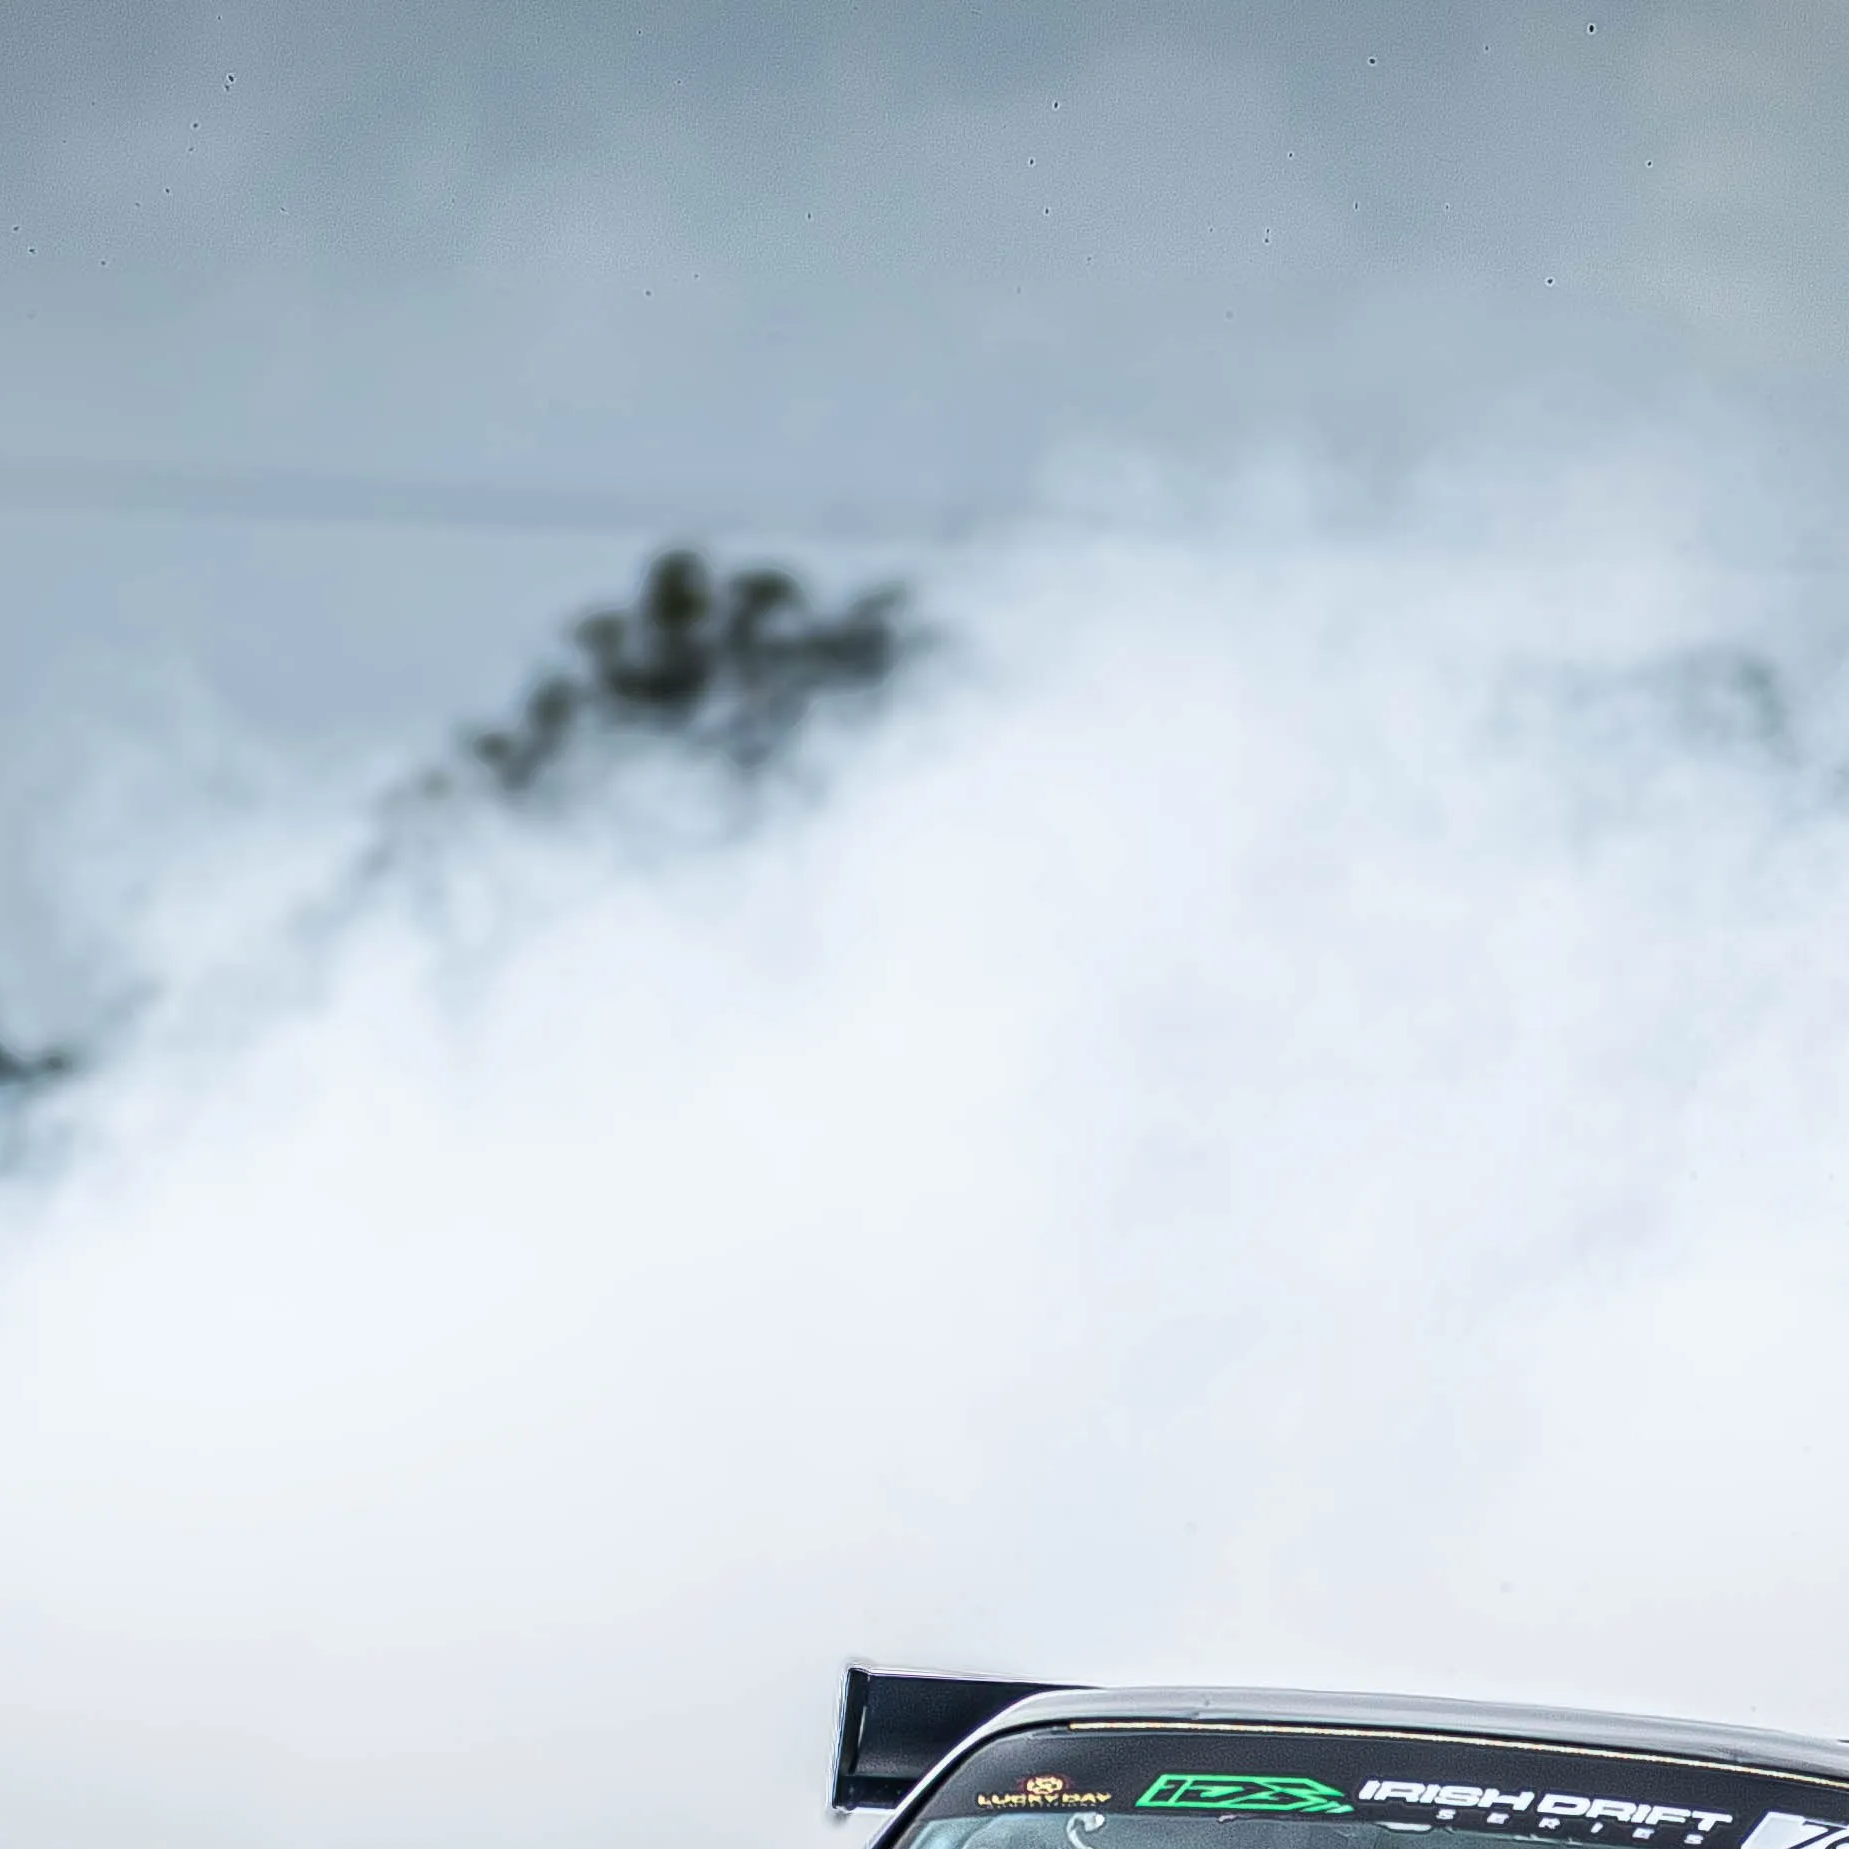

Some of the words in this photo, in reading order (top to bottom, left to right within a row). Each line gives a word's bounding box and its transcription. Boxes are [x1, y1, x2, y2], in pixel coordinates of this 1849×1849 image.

[1357, 1779, 1536, 1811] IRISH
[1536, 1792, 1734, 1832] DRIFT
[1435, 1808, 1705, 1845] SERIES
